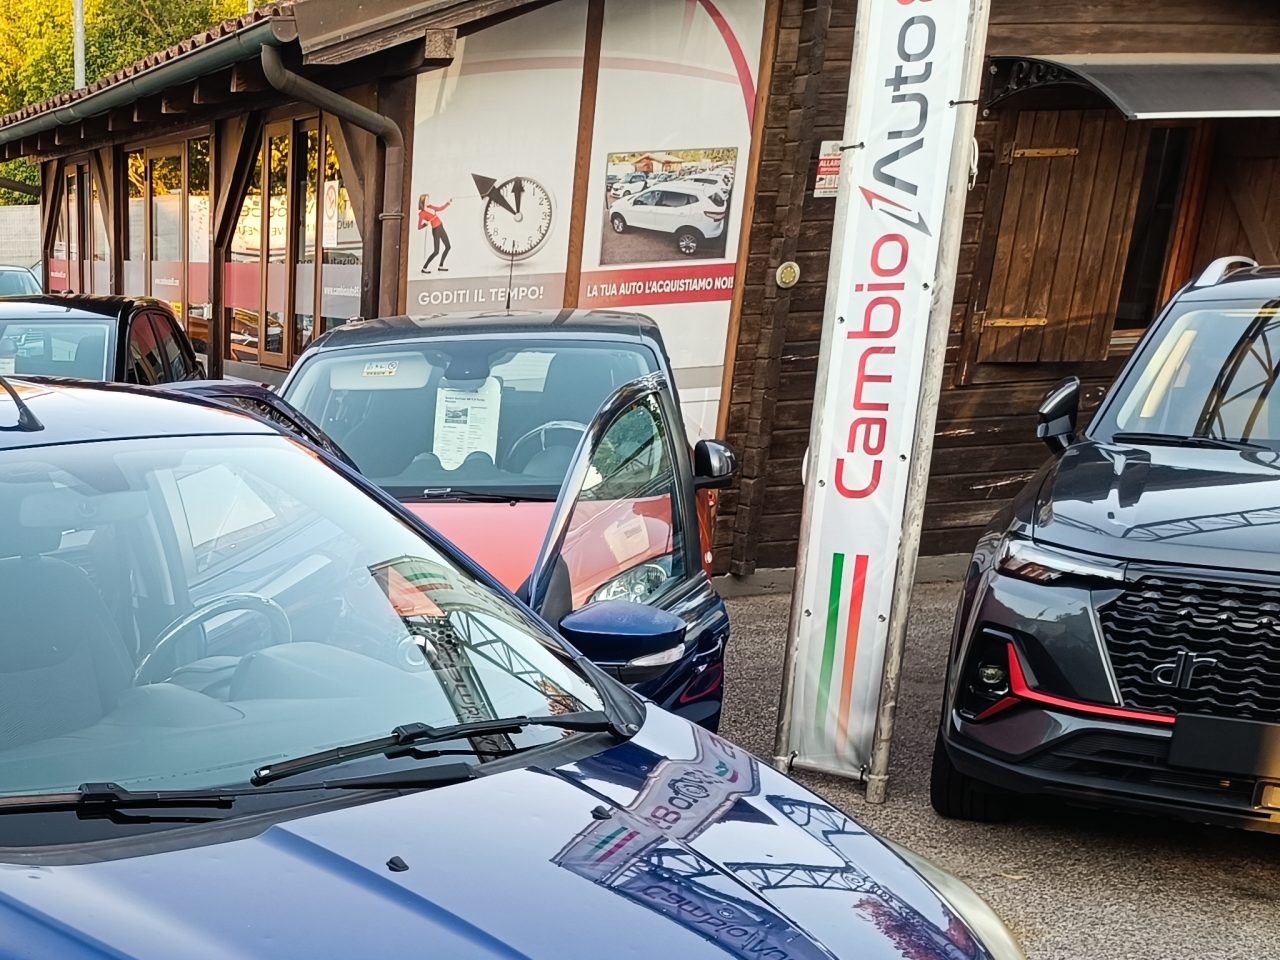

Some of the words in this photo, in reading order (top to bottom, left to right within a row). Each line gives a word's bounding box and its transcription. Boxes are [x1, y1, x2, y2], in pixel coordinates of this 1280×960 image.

[834, 233, 910, 499] Cambio
[872, 0, 937, 197] Auto
[418, 289, 470, 305] GODITI
[473, 289, 486, 302] IL
[489, 286, 545, 302] TEMPO!
[586, 284, 598, 297] LA
[600, 283, 618, 296] TUA
[619, 281, 644, 295] AUTO
[645, 277, 714, 294] L'ACQUISTIAMO
